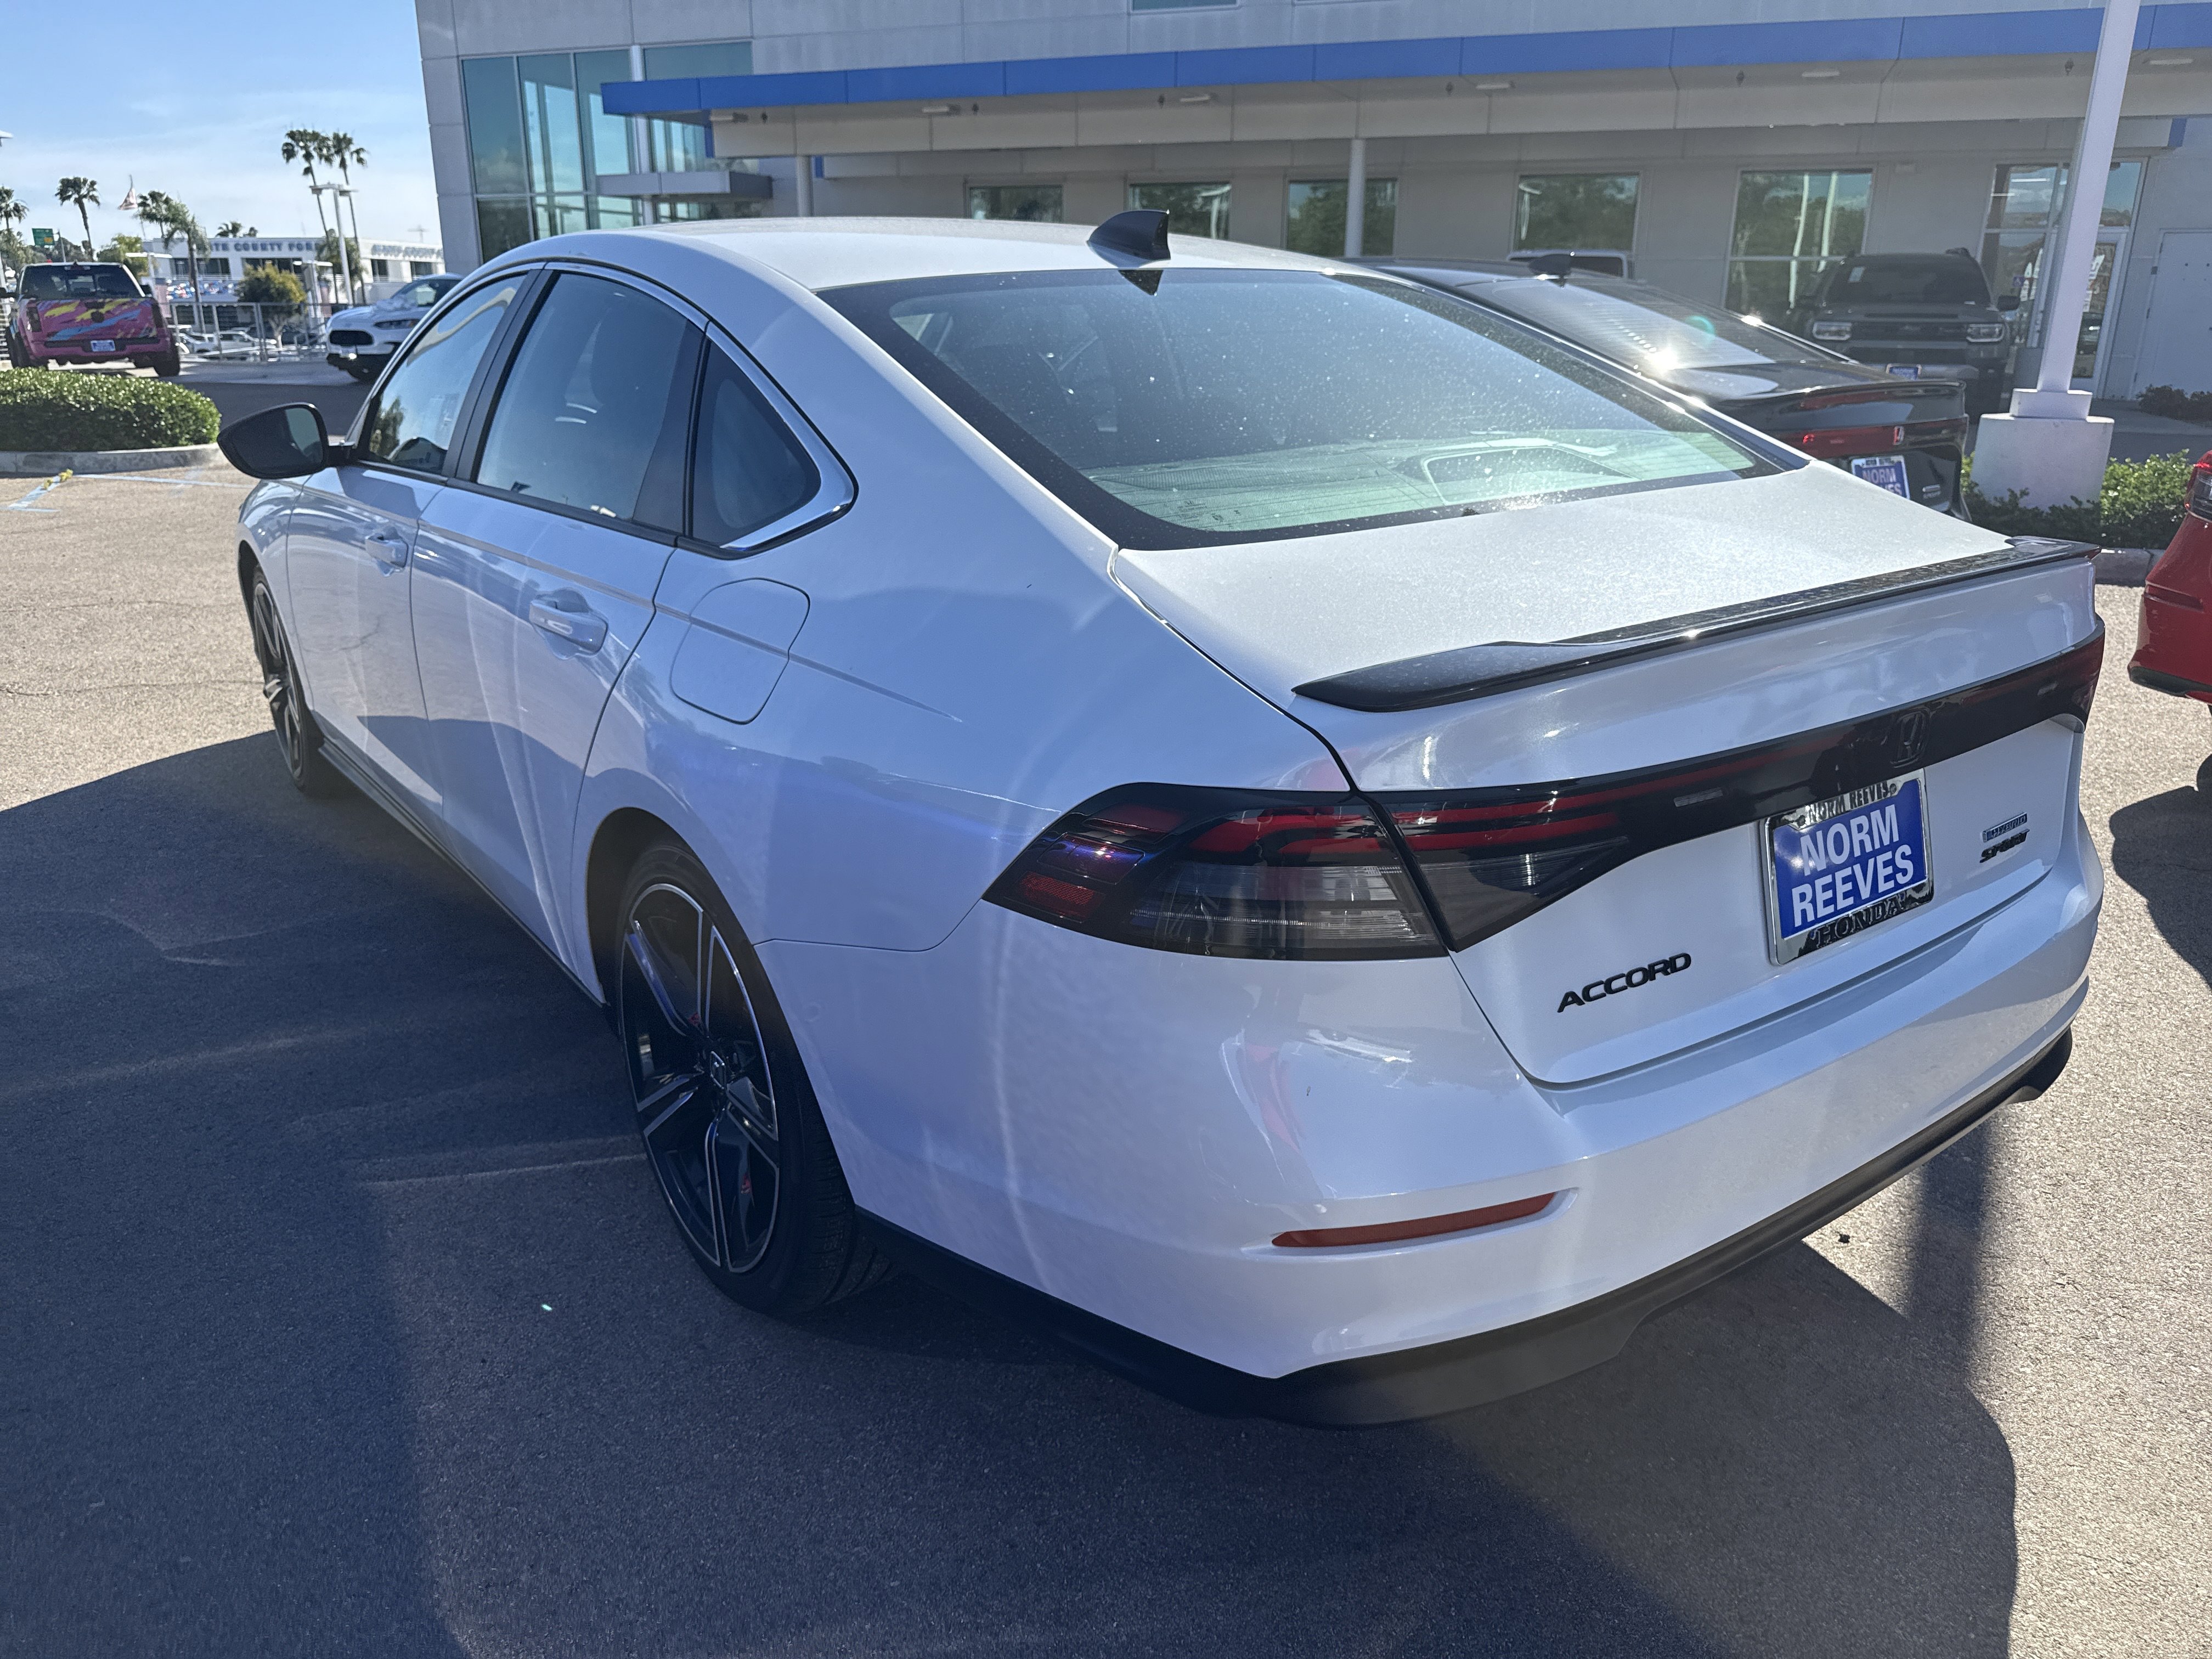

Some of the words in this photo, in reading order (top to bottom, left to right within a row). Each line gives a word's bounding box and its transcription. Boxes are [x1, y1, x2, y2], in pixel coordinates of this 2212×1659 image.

[1809, 794, 1846, 823] NORM
[1800, 804, 1900, 876] NORM
[1979, 828, 2030, 863] SPORT
[1791, 844, 1914, 927] REEVES
[1557, 952, 1691, 1013] ACCORD
